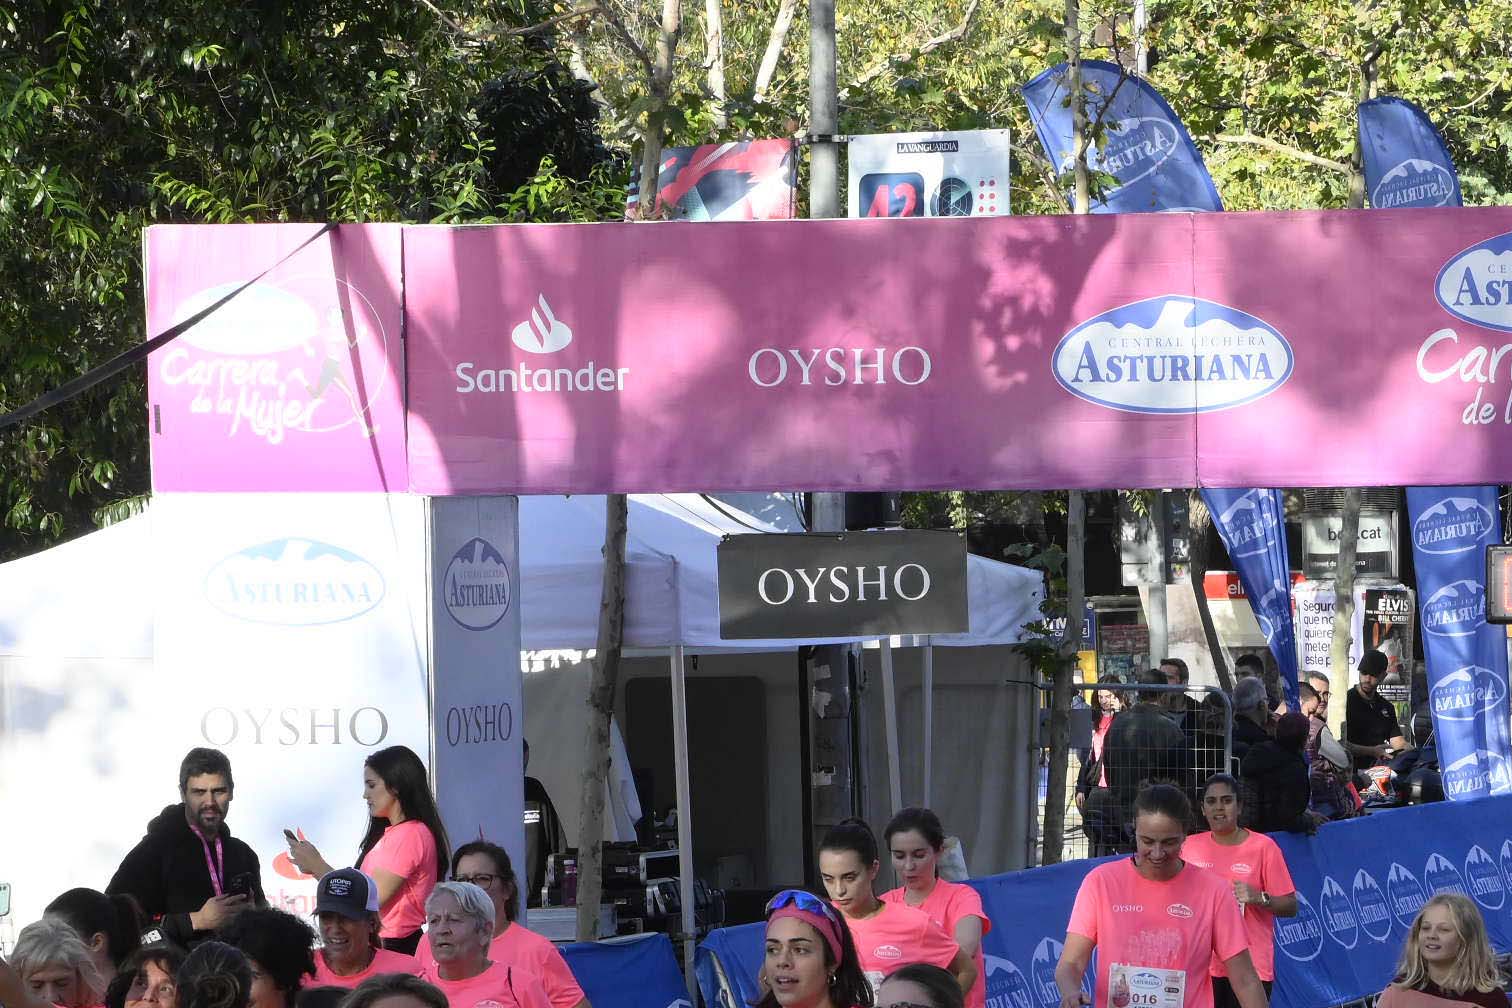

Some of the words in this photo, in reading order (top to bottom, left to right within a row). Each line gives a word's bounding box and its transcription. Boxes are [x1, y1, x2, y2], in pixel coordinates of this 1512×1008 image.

[1107, 336, 1184, 349] CENTRAL
[1191, 335, 1266, 347] LECHERA
[456, 361, 629, 393] Santander
[748, 346, 932, 386] OYSHO
[1072, 339, 1274, 384] ASTURIANA
[1462, 391, 1496, 426] de
[449, 572, 507, 608] ASTURIANA
[757, 563, 931, 605] OYSHO
[1378, 598, 1409, 611] ELVIS
[200, 706, 389, 747] OYSHO
[445, 701, 513, 748] OYSHO
[1132, 993, 1158, 1005] 016
